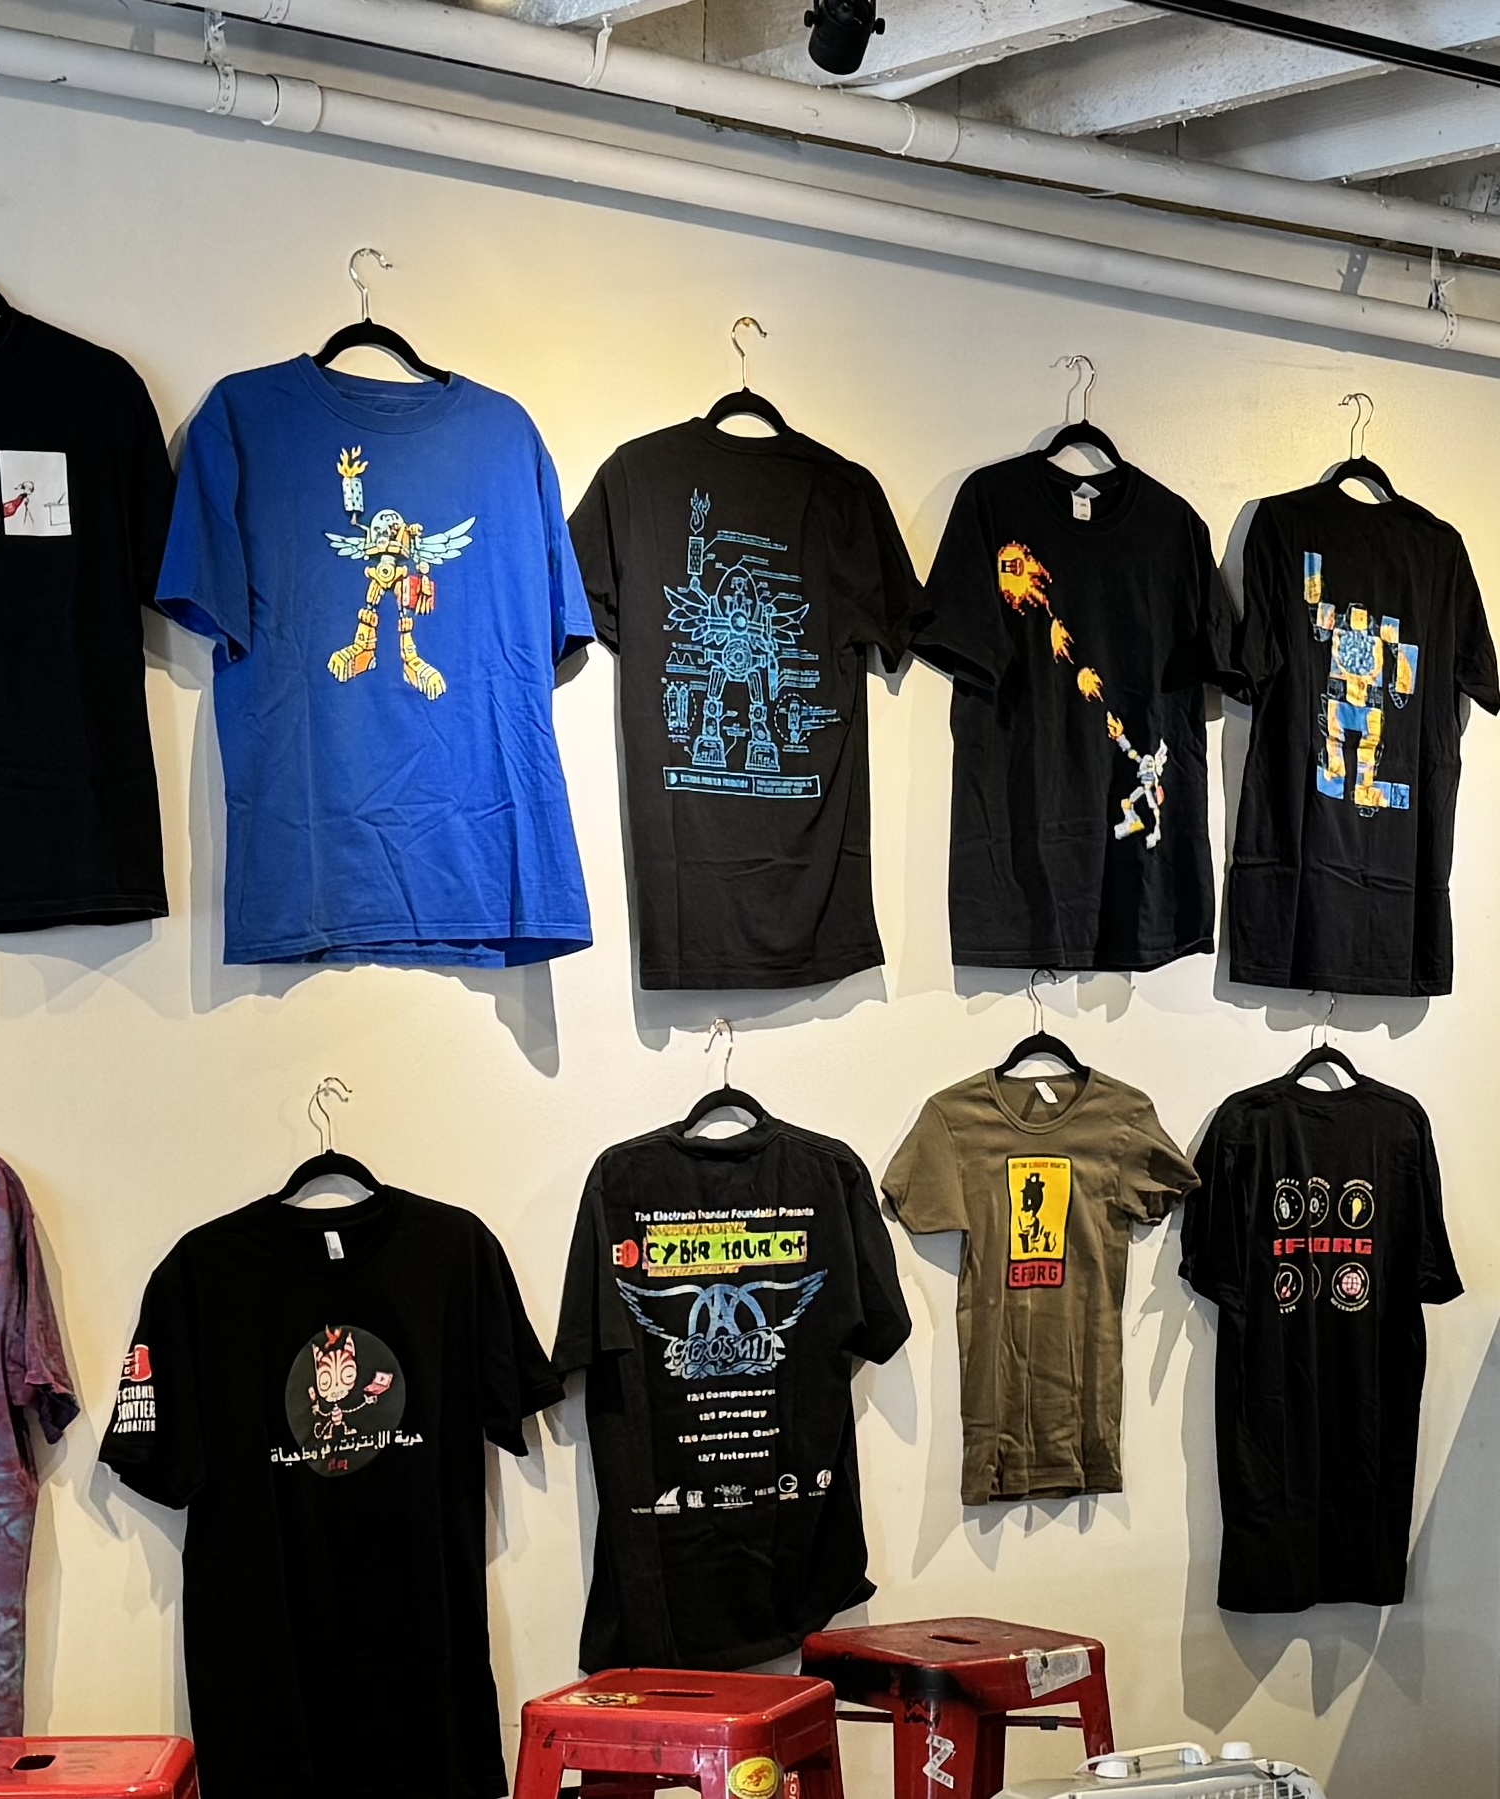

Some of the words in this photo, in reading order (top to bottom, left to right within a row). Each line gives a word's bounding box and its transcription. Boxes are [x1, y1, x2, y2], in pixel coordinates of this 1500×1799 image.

[647, 1239, 711, 1265] CYBER
[721, 1237, 771, 1260] TOUR
[718, 1409, 768, 1419] Prodigy
[394, 1429, 424, 1446] حرية
[719, 1449, 770, 1461] Internet
